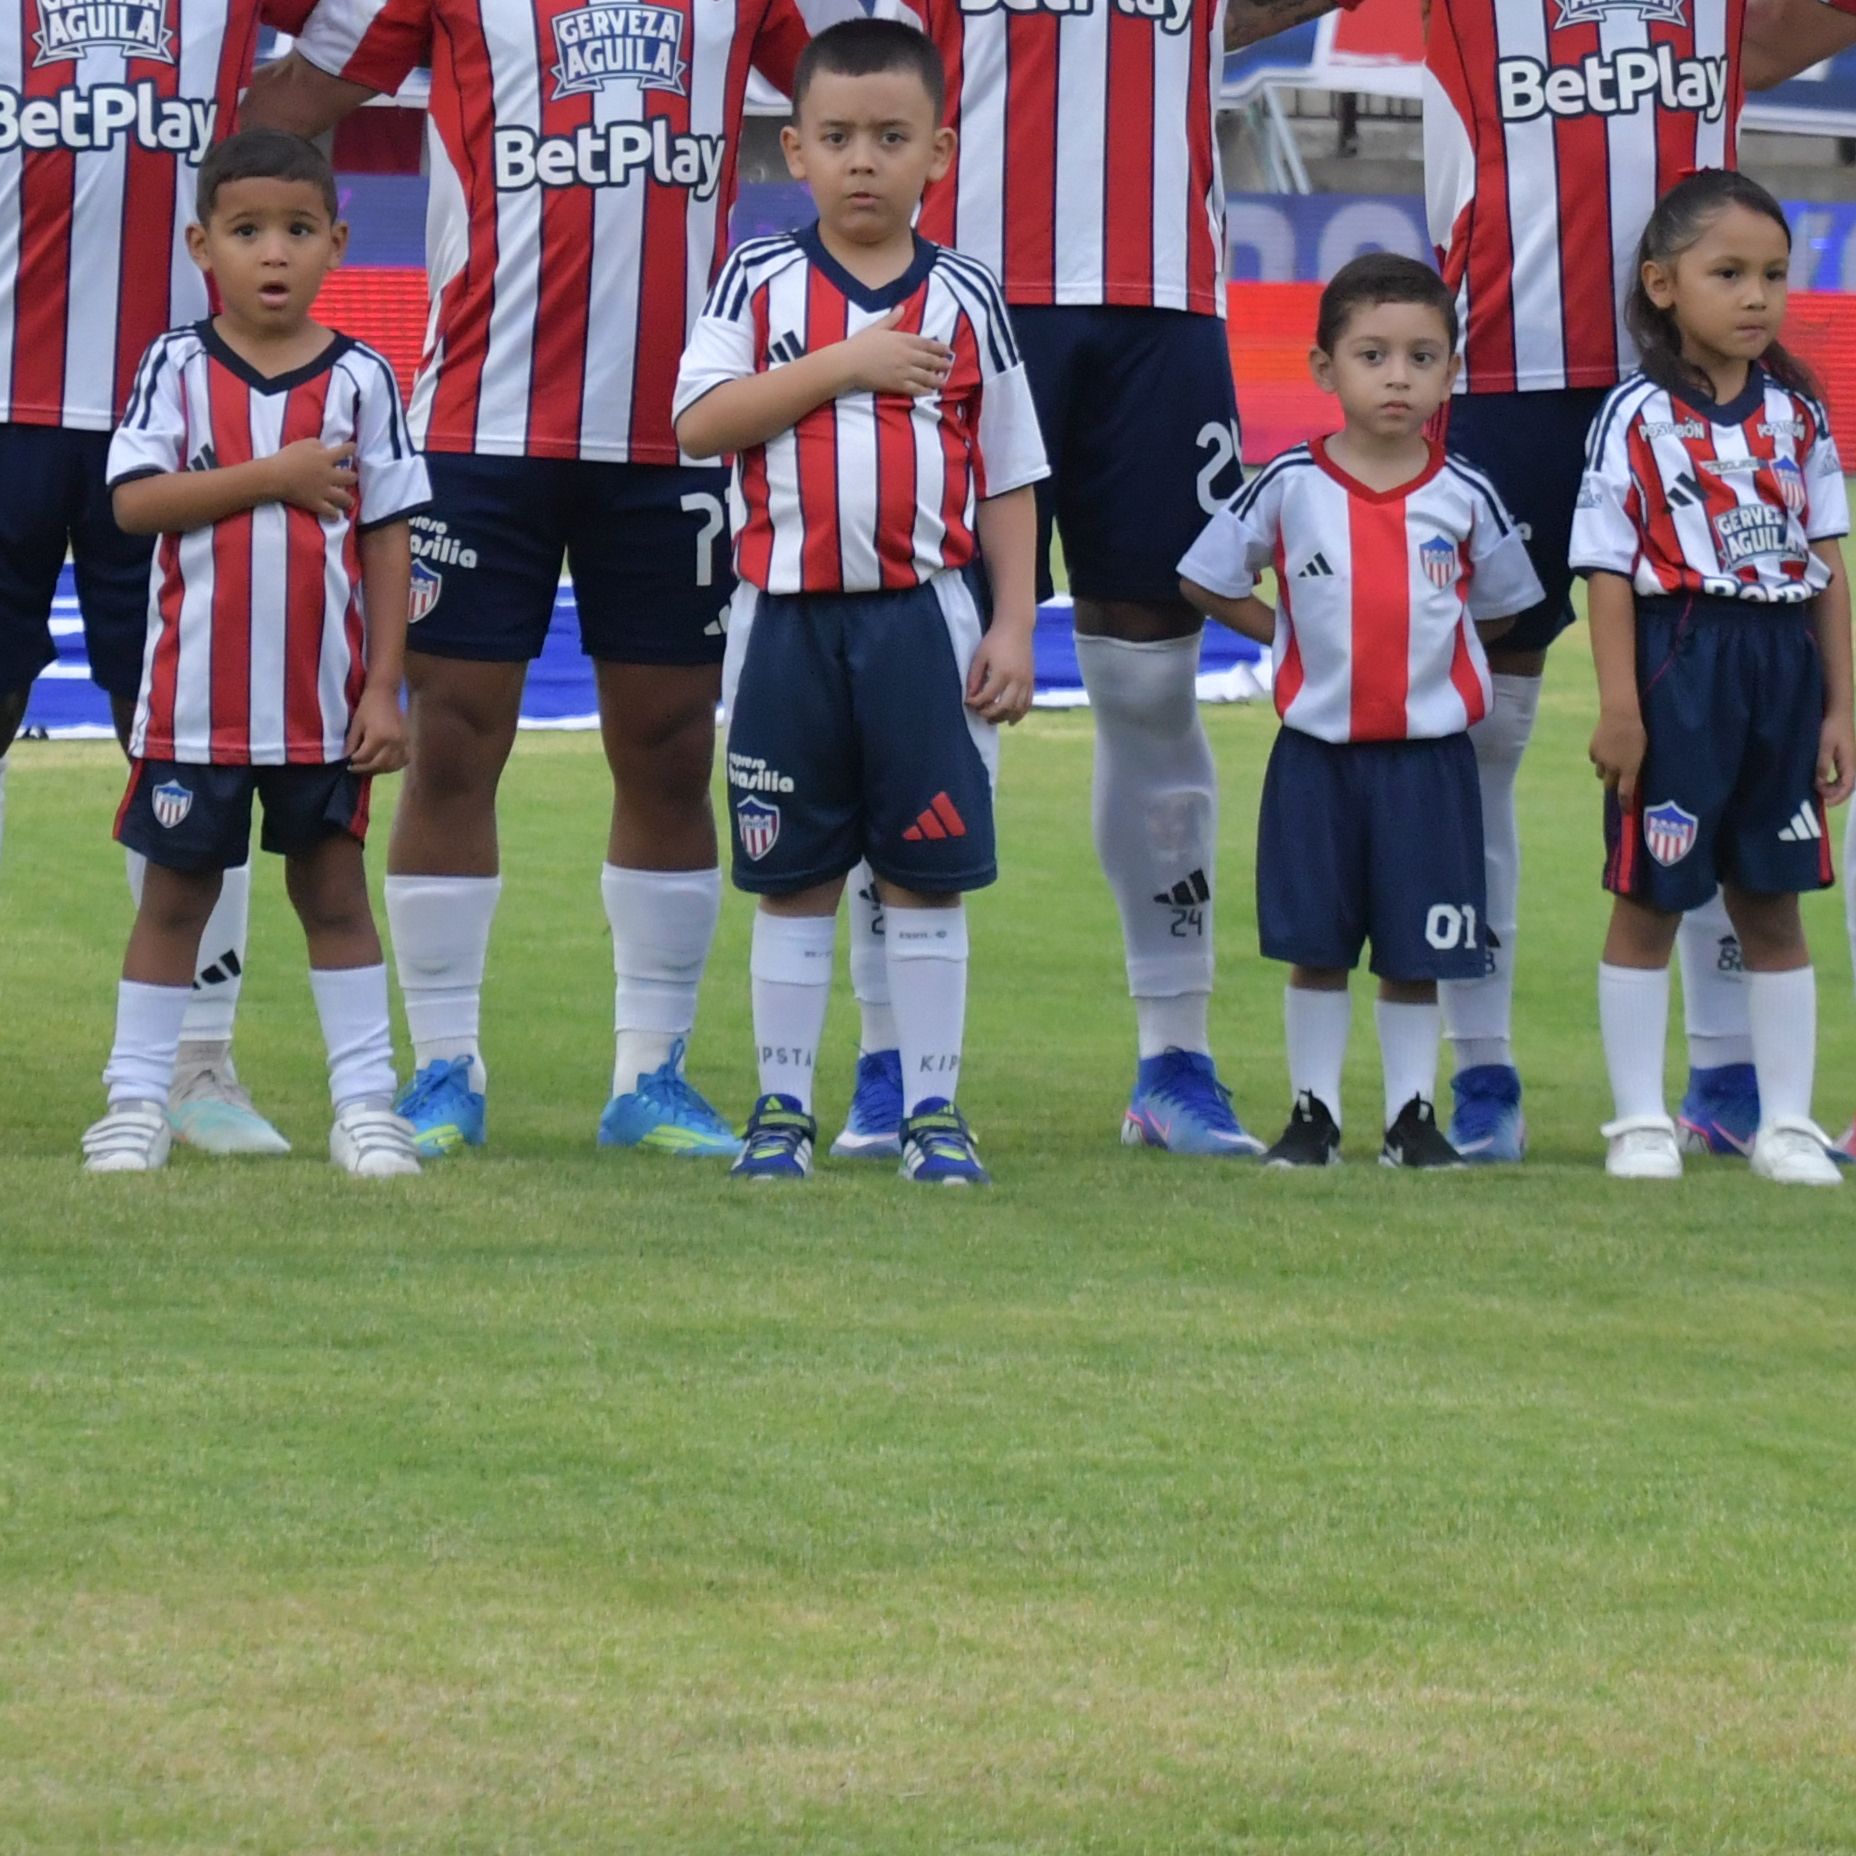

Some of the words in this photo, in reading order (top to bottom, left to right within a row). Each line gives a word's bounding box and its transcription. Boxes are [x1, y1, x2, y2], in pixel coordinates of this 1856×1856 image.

[50, 10, 157, 44] AGUILA
[567, 40, 672, 77] AGUILA
[1497, 47, 1729, 122] BetPlay
[494, 118, 725, 202] BetPlay
[1169, 907, 1204, 938] 24
[1425, 902, 1477, 950] 01
